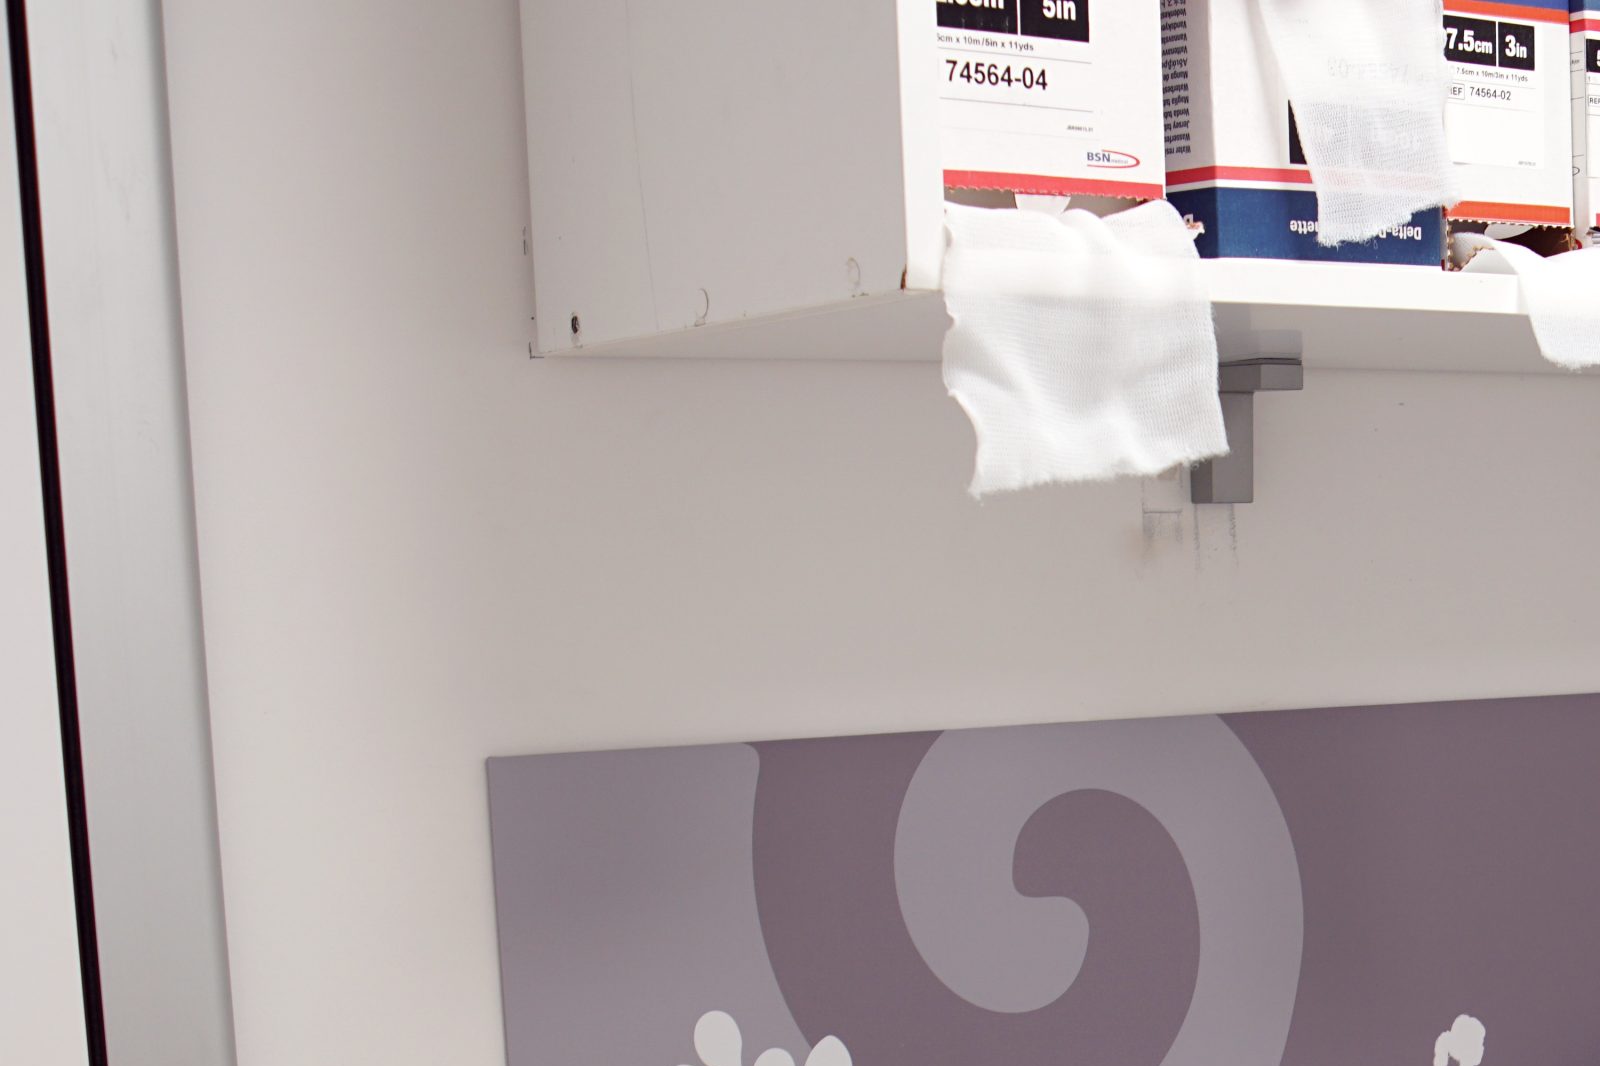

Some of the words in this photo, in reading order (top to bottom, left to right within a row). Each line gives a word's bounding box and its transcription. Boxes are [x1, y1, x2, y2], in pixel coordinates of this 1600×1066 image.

[963, 36, 999, 49] 10m/5in
[1009, 41, 1034, 51] 11yds
[1446, 27, 1494, 55] 7.5cm
[1504, 34, 1528, 59] 3in
[945, 58, 1048, 91] 74564-04
[1456, 66, 1475, 76] 7.5cm
[1469, 86, 1512, 101] 74564-02
[1087, 151, 1111, 164] BSN
